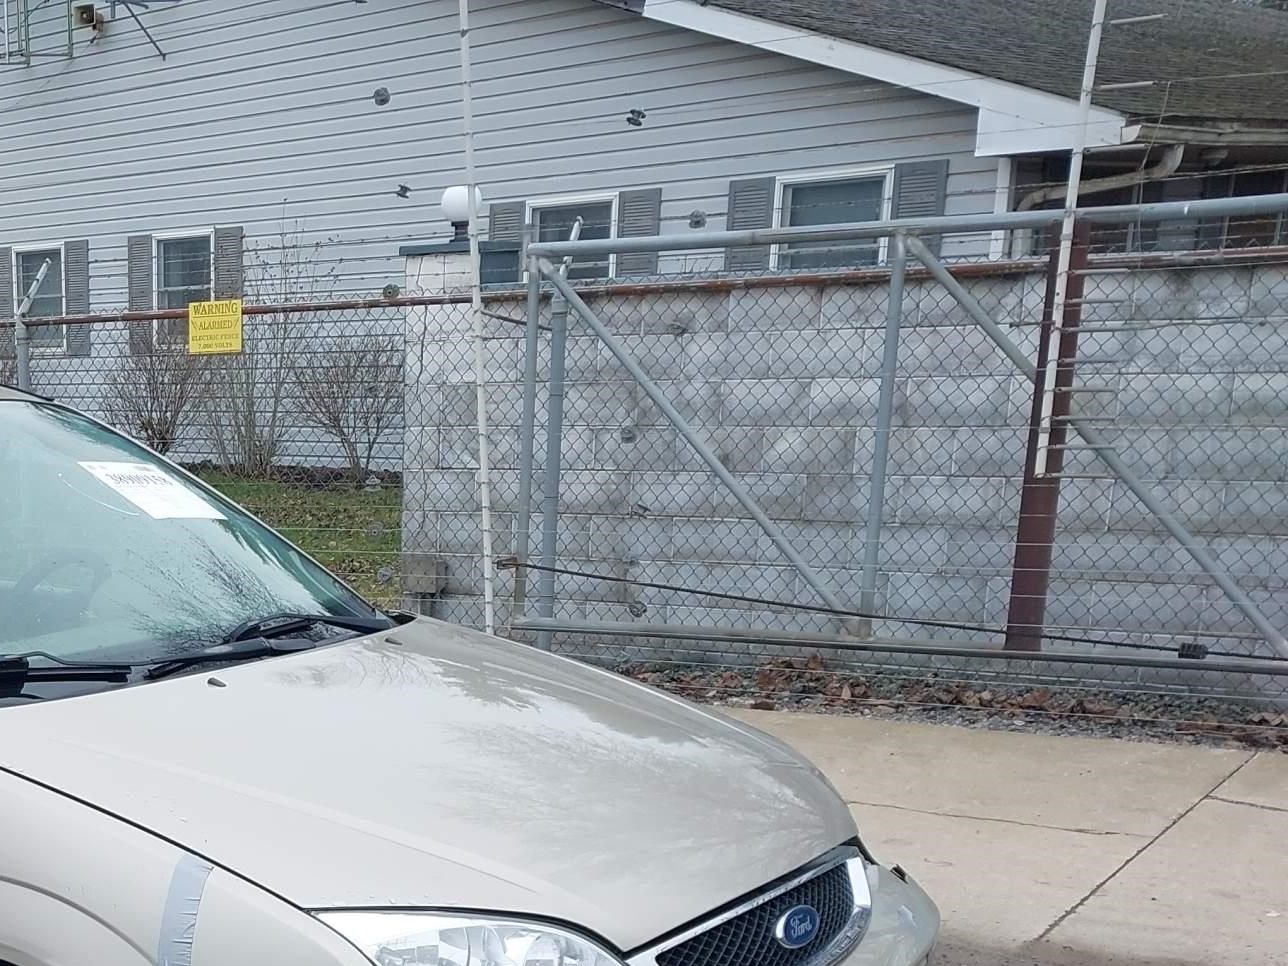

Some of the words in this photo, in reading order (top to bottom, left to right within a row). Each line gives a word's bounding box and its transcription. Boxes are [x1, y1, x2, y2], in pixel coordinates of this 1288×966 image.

[193, 303, 238, 315] WARNING
[199, 320, 232, 330] ALARMED
[790, 914, 812, 938] Ford
